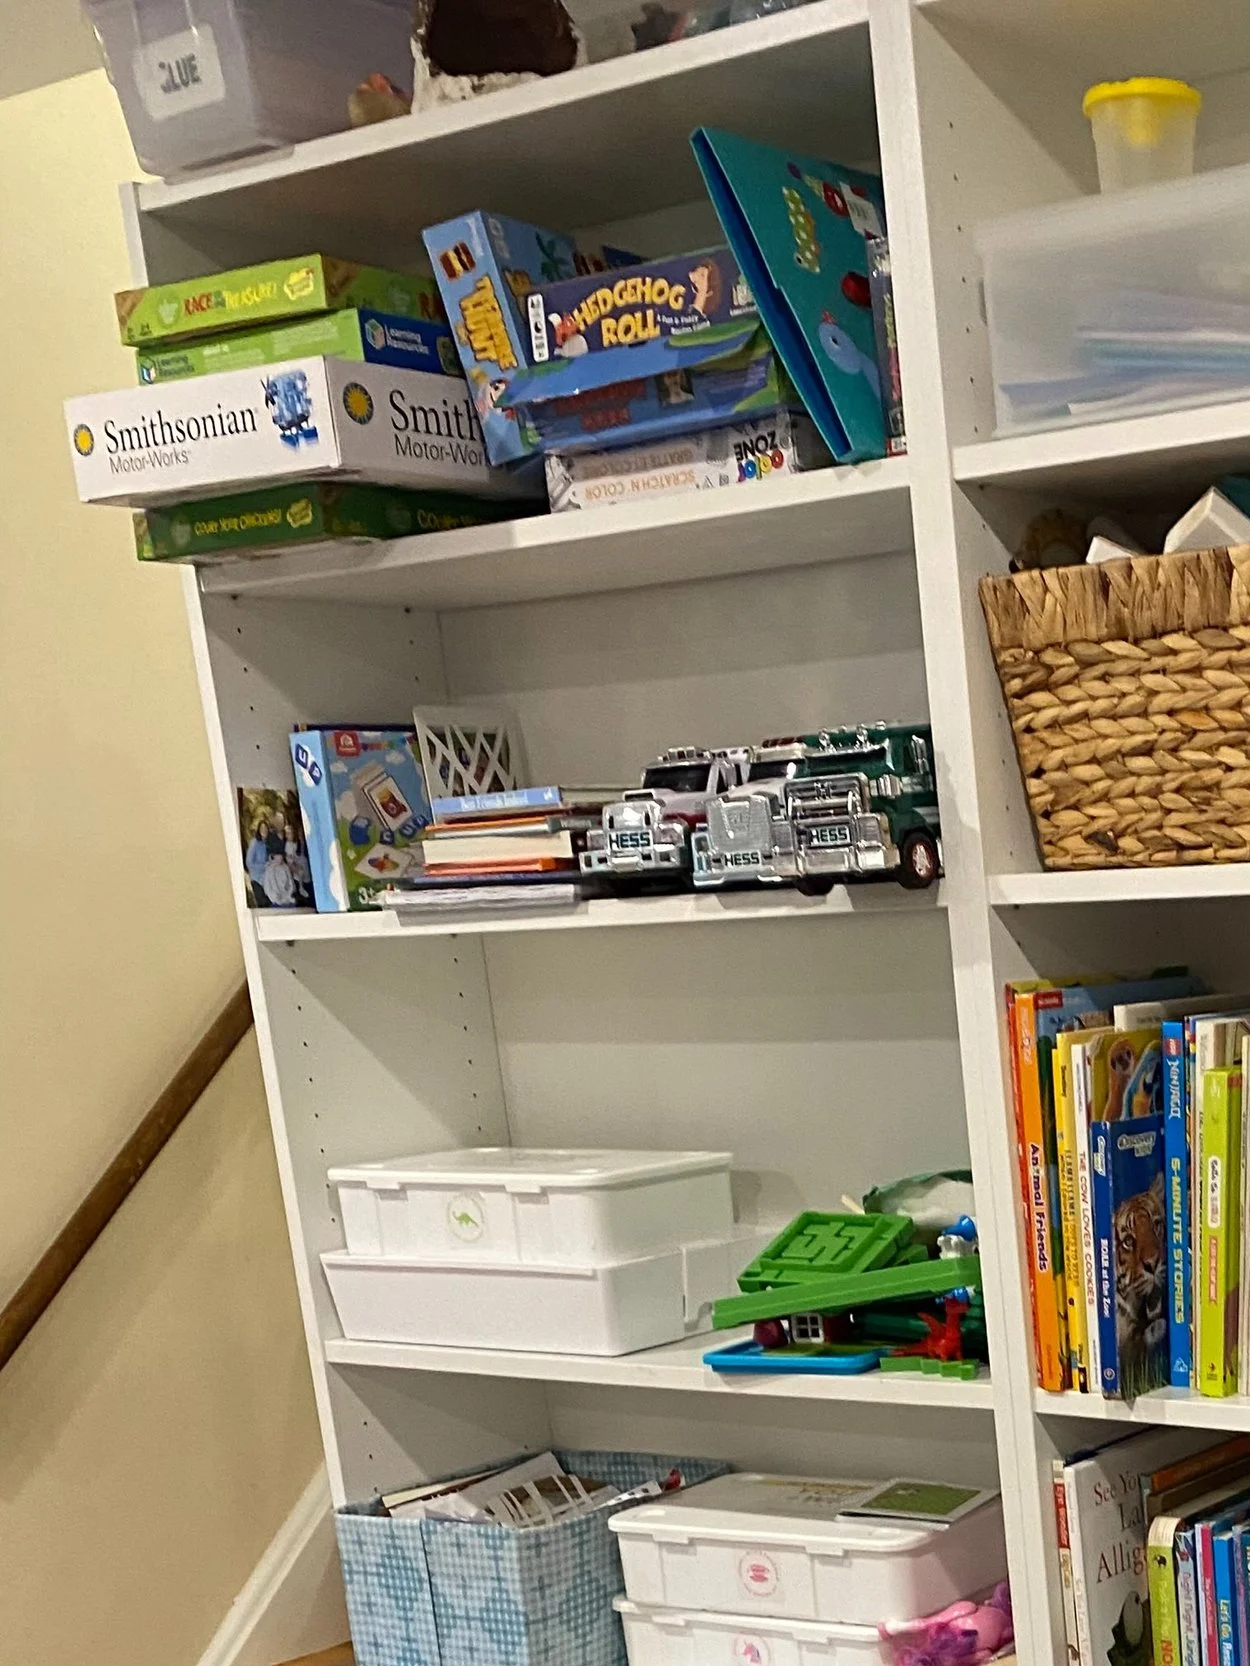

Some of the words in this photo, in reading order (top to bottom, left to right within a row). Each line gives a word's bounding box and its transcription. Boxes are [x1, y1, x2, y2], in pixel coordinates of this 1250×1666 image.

[571, 277, 686, 331] HEDGEHOG
[602, 309, 661, 347] ROLL
[104, 403, 257, 454] Smithsonian
[109, 448, 188, 475] Motor-Works
[394, 434, 484, 467] Motor-Wor
[735, 431, 777, 462] ZONE
[583, 480, 625, 501] COLOR
[608, 830, 651, 848] HESS
[810, 827, 848, 845] HESS
[724, 852, 760, 867] HESS
[1166, 1059, 1181, 1118] NINJAGO
[1078, 1151, 1087, 1171] THE
[1080, 1174, 1089, 1204] COW
[1034, 1212, 1050, 1271] Friends
[1082, 1207, 1091, 1247] LOVES
[1100, 1239, 1109, 1267] ROAR
[1085, 1252, 1095, 1305] COOKIES
[1102, 1280, 1110, 1295] the
[1172, 1249, 1185, 1323] STORIES
[1094, 1482, 1116, 1506] See
[1096, 1540, 1147, 1584] Allig
[1218, 1599, 1231, 1622] Let's
